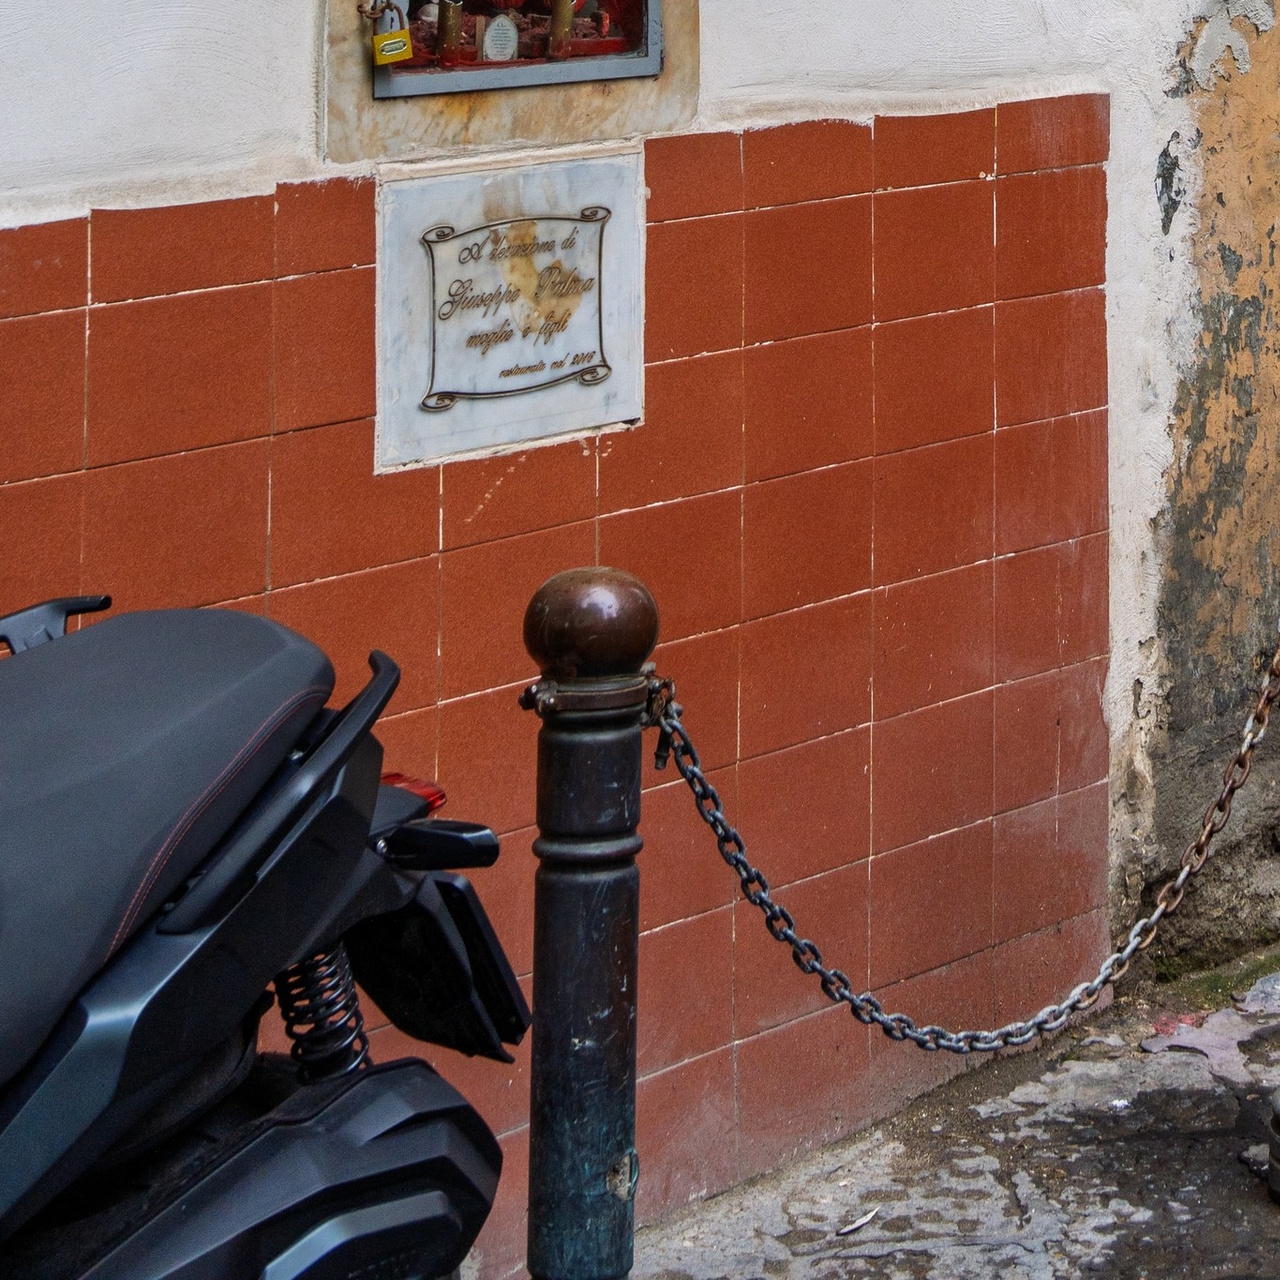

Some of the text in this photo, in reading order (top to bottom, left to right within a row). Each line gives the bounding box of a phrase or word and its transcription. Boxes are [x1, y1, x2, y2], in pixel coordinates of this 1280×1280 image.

[458, 226, 580, 265] A devozione di
[438, 266, 595, 321] Giuseppe Palma
[465, 309, 573, 356] moglie e figli
